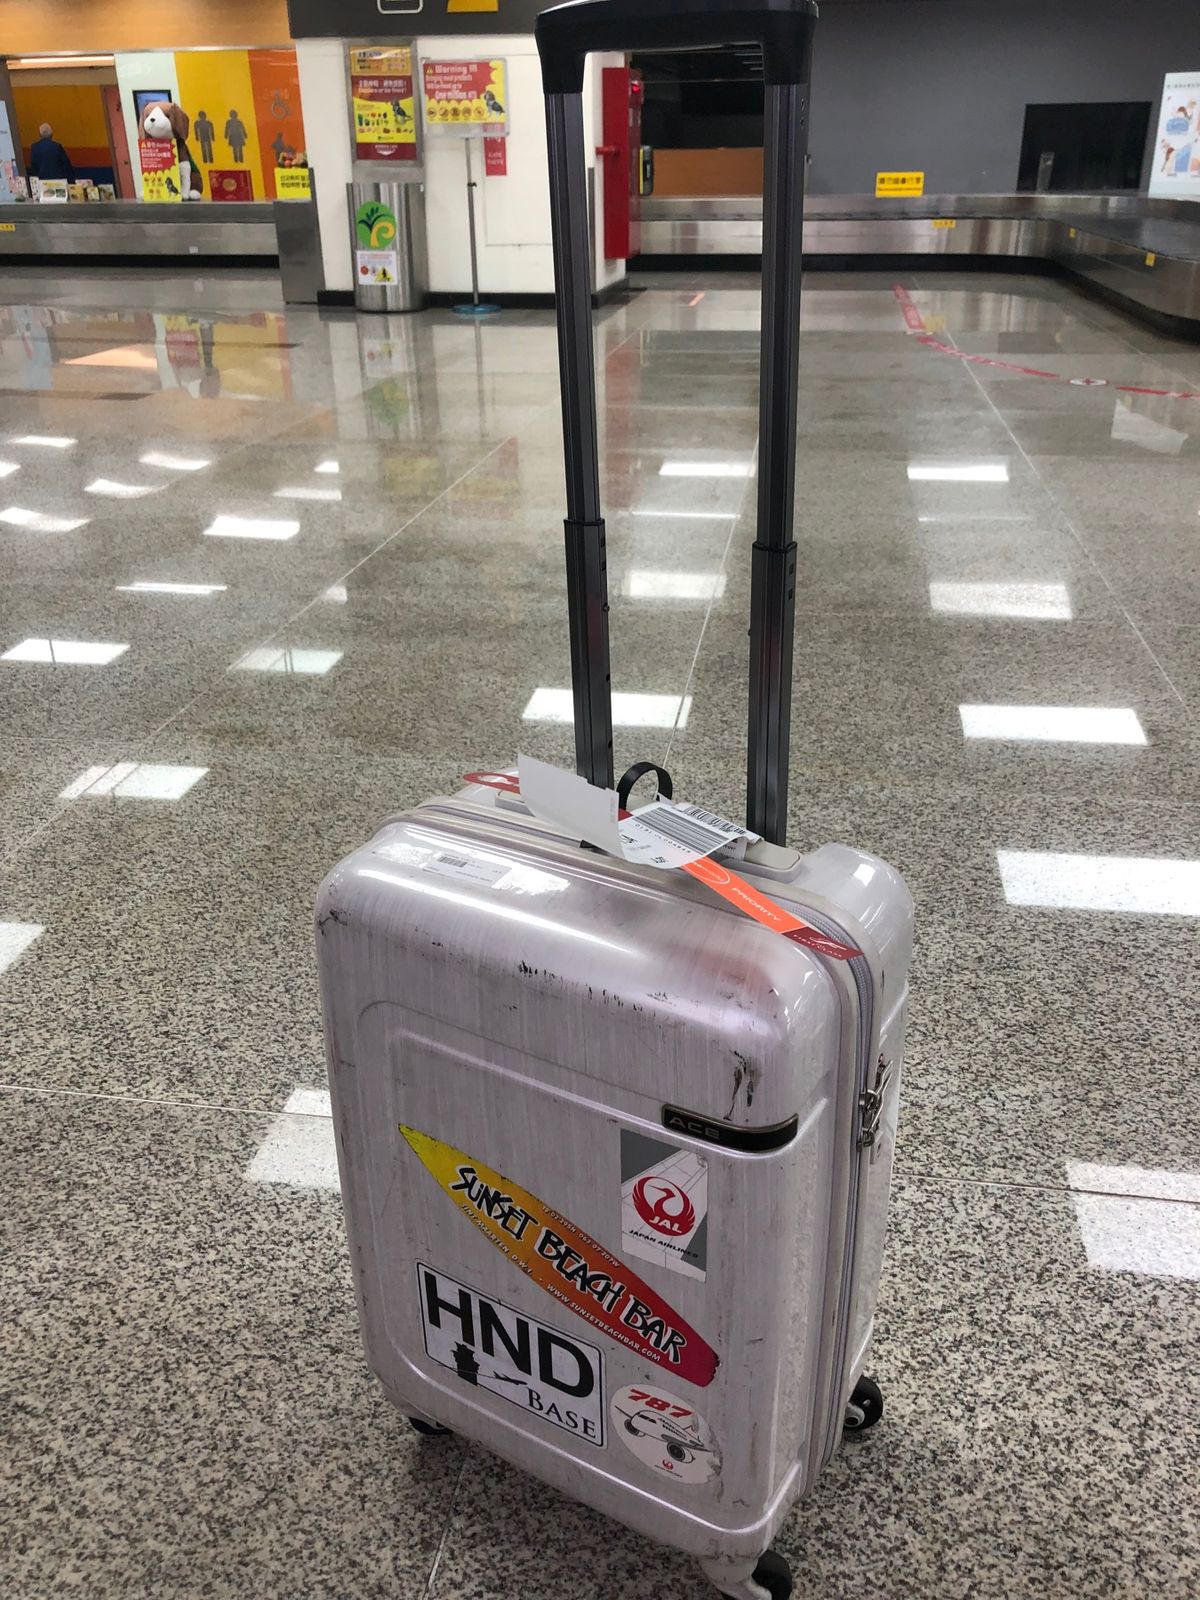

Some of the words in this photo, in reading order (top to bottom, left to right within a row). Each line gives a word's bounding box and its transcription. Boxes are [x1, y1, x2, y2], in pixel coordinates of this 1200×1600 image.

[435, 64, 468, 74] Warning
[731, 886, 782, 922] PRIORITY
[668, 1116, 720, 1140] ACE
[648, 1216, 683, 1234] JAL
[628, 1229, 656, 1244] JAPAN
[657, 1240, 700, 1259] AIRLINES
[451, 1166, 539, 1241] SUNSET
[536, 1227, 625, 1313] BEACH
[621, 1295, 686, 1363] BAR
[424, 1271, 594, 1398] HND
[546, 1284, 661, 1362] WWW.SUNSETBEACHBAR.COM
[526, 1386, 597, 1438] BASE
[628, 1388, 693, 1418] 787
